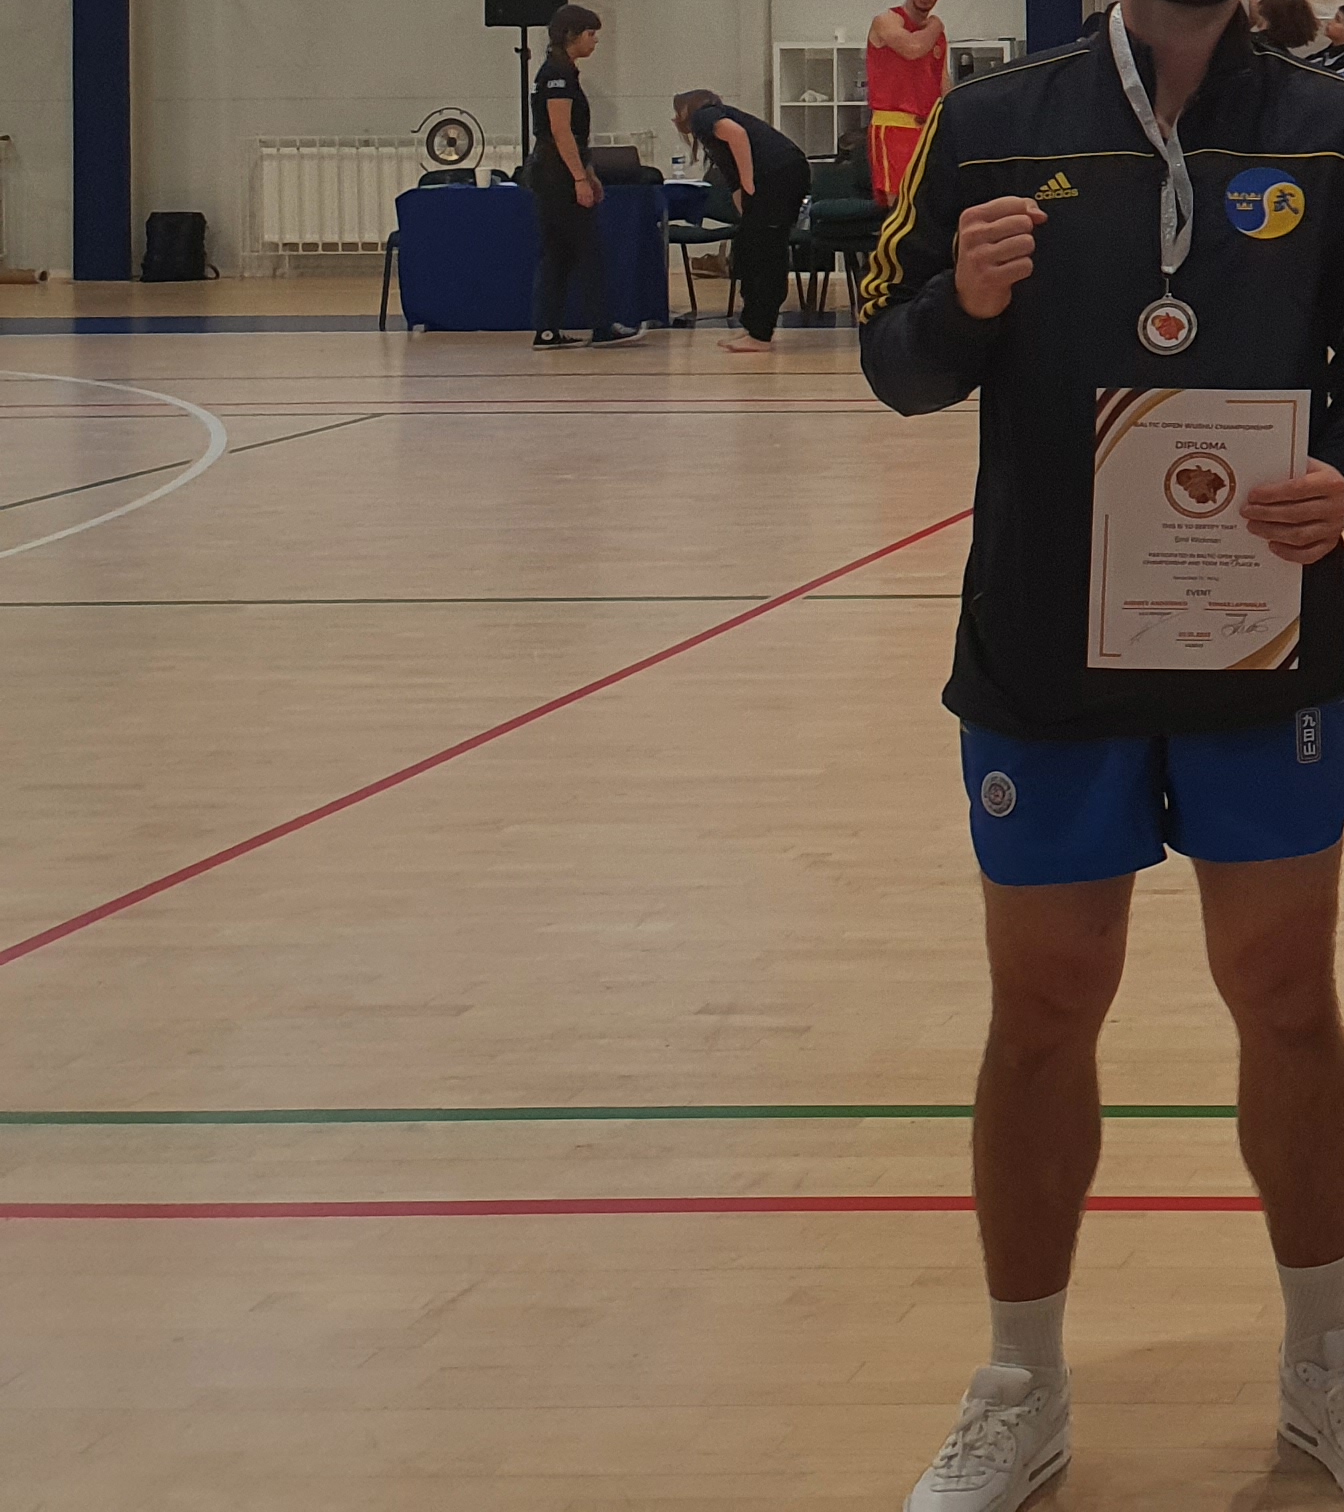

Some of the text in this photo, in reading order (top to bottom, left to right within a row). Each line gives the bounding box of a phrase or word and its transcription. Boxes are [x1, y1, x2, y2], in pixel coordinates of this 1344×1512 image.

[1034, 188, 1079, 201] adidas
[1175, 440, 1227, 450] DIPLOMA
[1186, 589, 1212, 597] EVENT
[1301, 714, 1317, 756] 九日山
